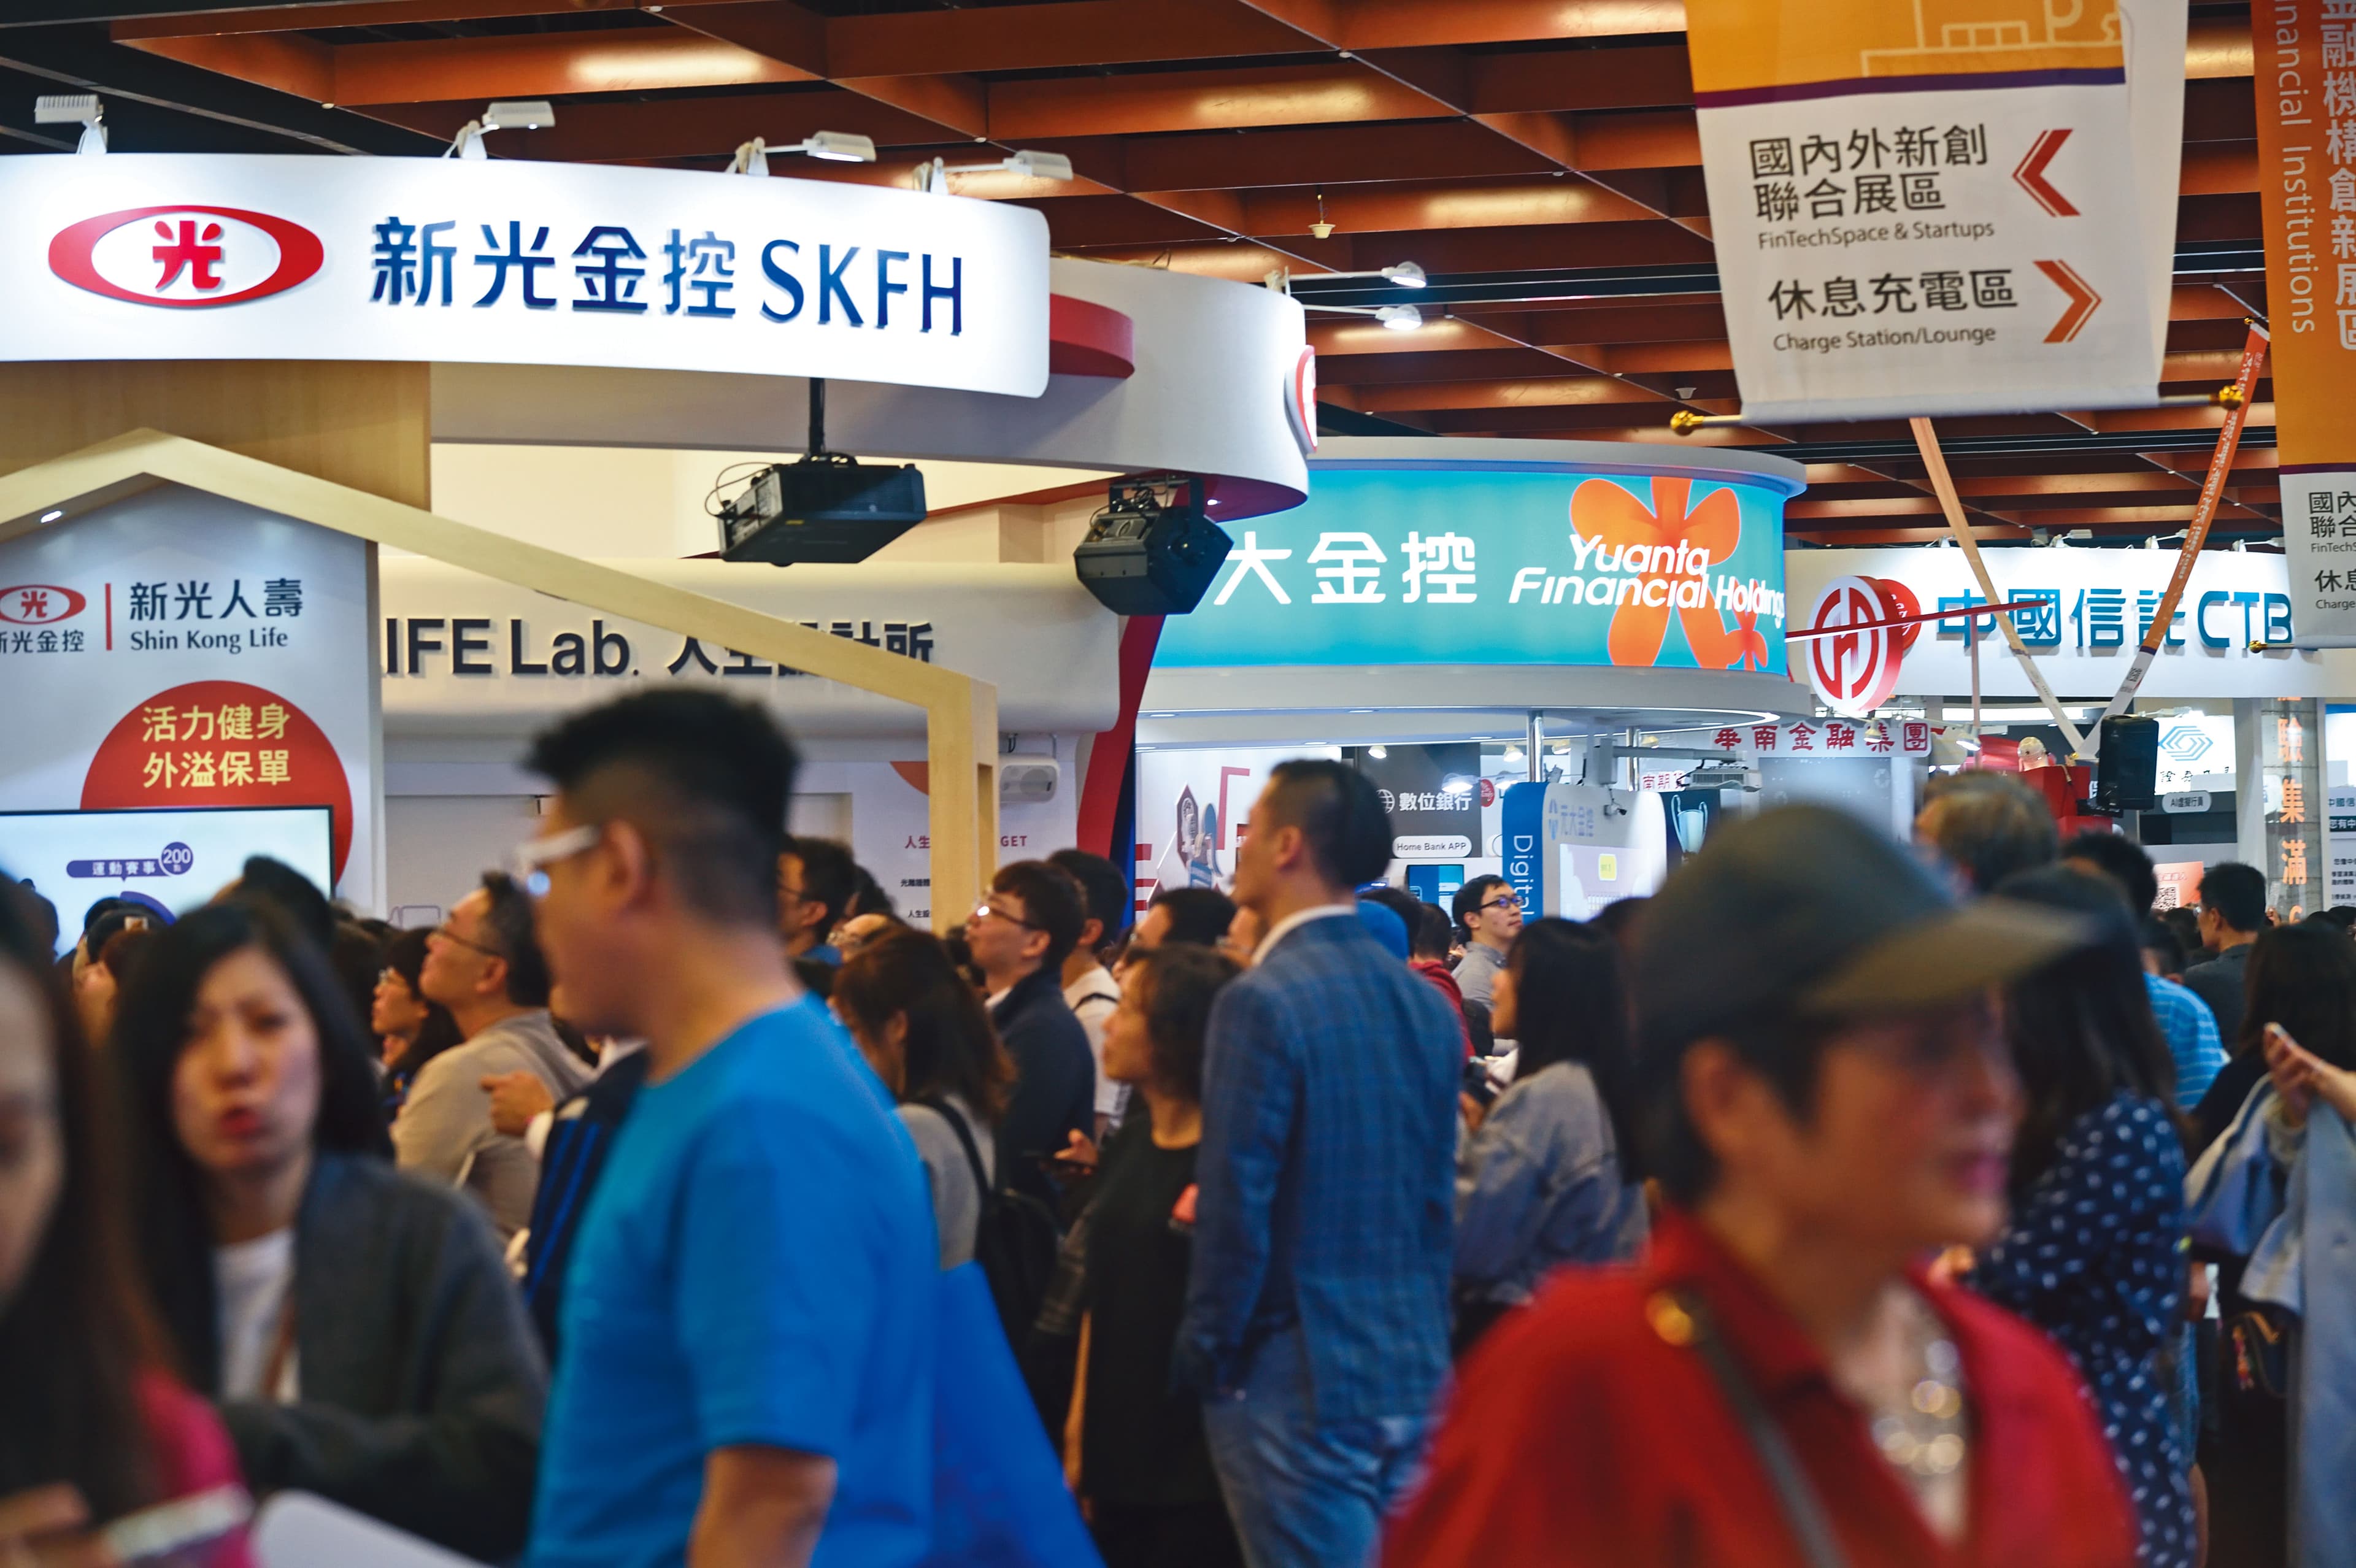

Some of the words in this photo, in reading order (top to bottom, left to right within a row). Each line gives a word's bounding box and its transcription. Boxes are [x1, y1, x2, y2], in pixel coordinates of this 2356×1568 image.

[1749, 123, 1988, 180] 國內外新創
[1754, 172, 1946, 223] 聯合展區
[153, 220, 223, 291] 光
[1758, 226, 1889, 250] FinTechSpace
[1894, 222, 1908, 241] &
[1912, 220, 1995, 243] Startups
[2282, 145, 2318, 334] Institutions
[370, 215, 736, 317] 新光金控
[760, 239, 963, 336] SKFH
[1768, 269, 2018, 321] 休息充電區
[1773, 333, 1841, 353] Charge
[1846, 326, 1996, 349] Station/Lounge
[2309, 515, 2356, 538] 聯合
[1213, 531, 1478, 605] 大金控
[1569, 533, 1711, 576] Yuanta
[20, 590, 48, 619] 光
[129, 578, 303, 621] 新光人壽
[1508, 567, 1710, 609] Financial
[1714, 574, 1785, 629] Holdings
[1936, 588, 2186, 648] 中國信託
[2315, 599, 2356, 610] Charge
[0, 629, 85, 654] 光金控
[130, 630, 179, 651] Shin
[187, 629, 242, 654] Kong
[249, 627, 288, 648] Life
[510, 618, 639, 675] Lab.
[142, 703, 291, 742] 活力健身
[142, 750, 291, 789] 外溢保單
[1398, 791, 1472, 812] 數位銀行
[163, 848, 191, 864] 200
